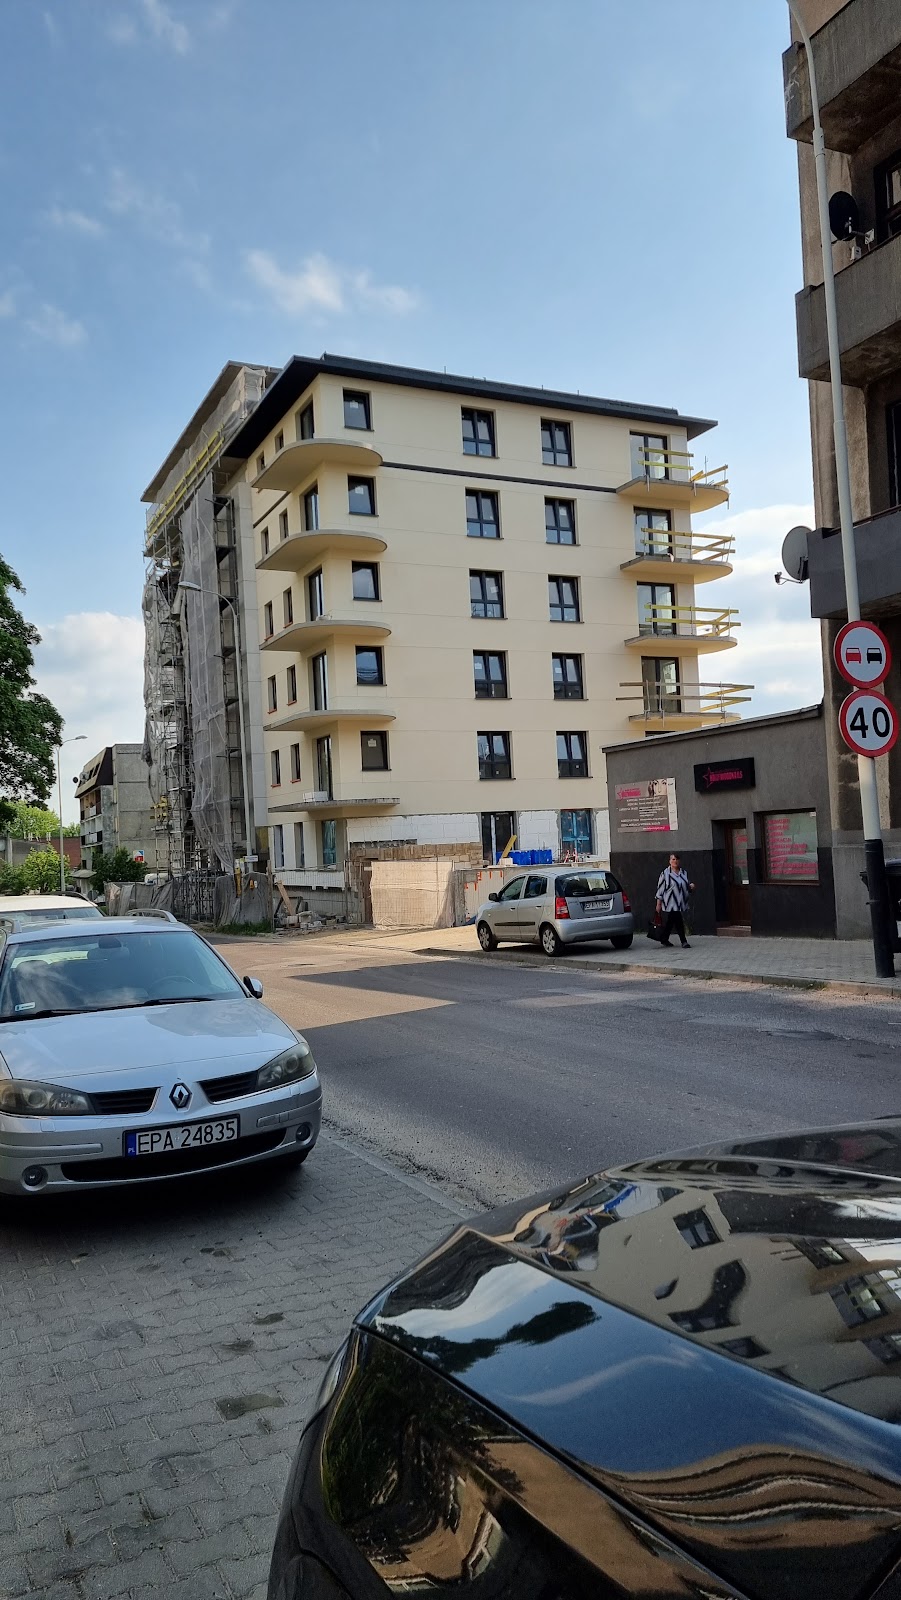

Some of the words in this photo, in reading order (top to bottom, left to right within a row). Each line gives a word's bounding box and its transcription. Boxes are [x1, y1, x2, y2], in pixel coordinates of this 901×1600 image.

[849, 706, 891, 739] 40
[137, 1130, 174, 1153] EPA
[180, 1120, 236, 1147] 24835
